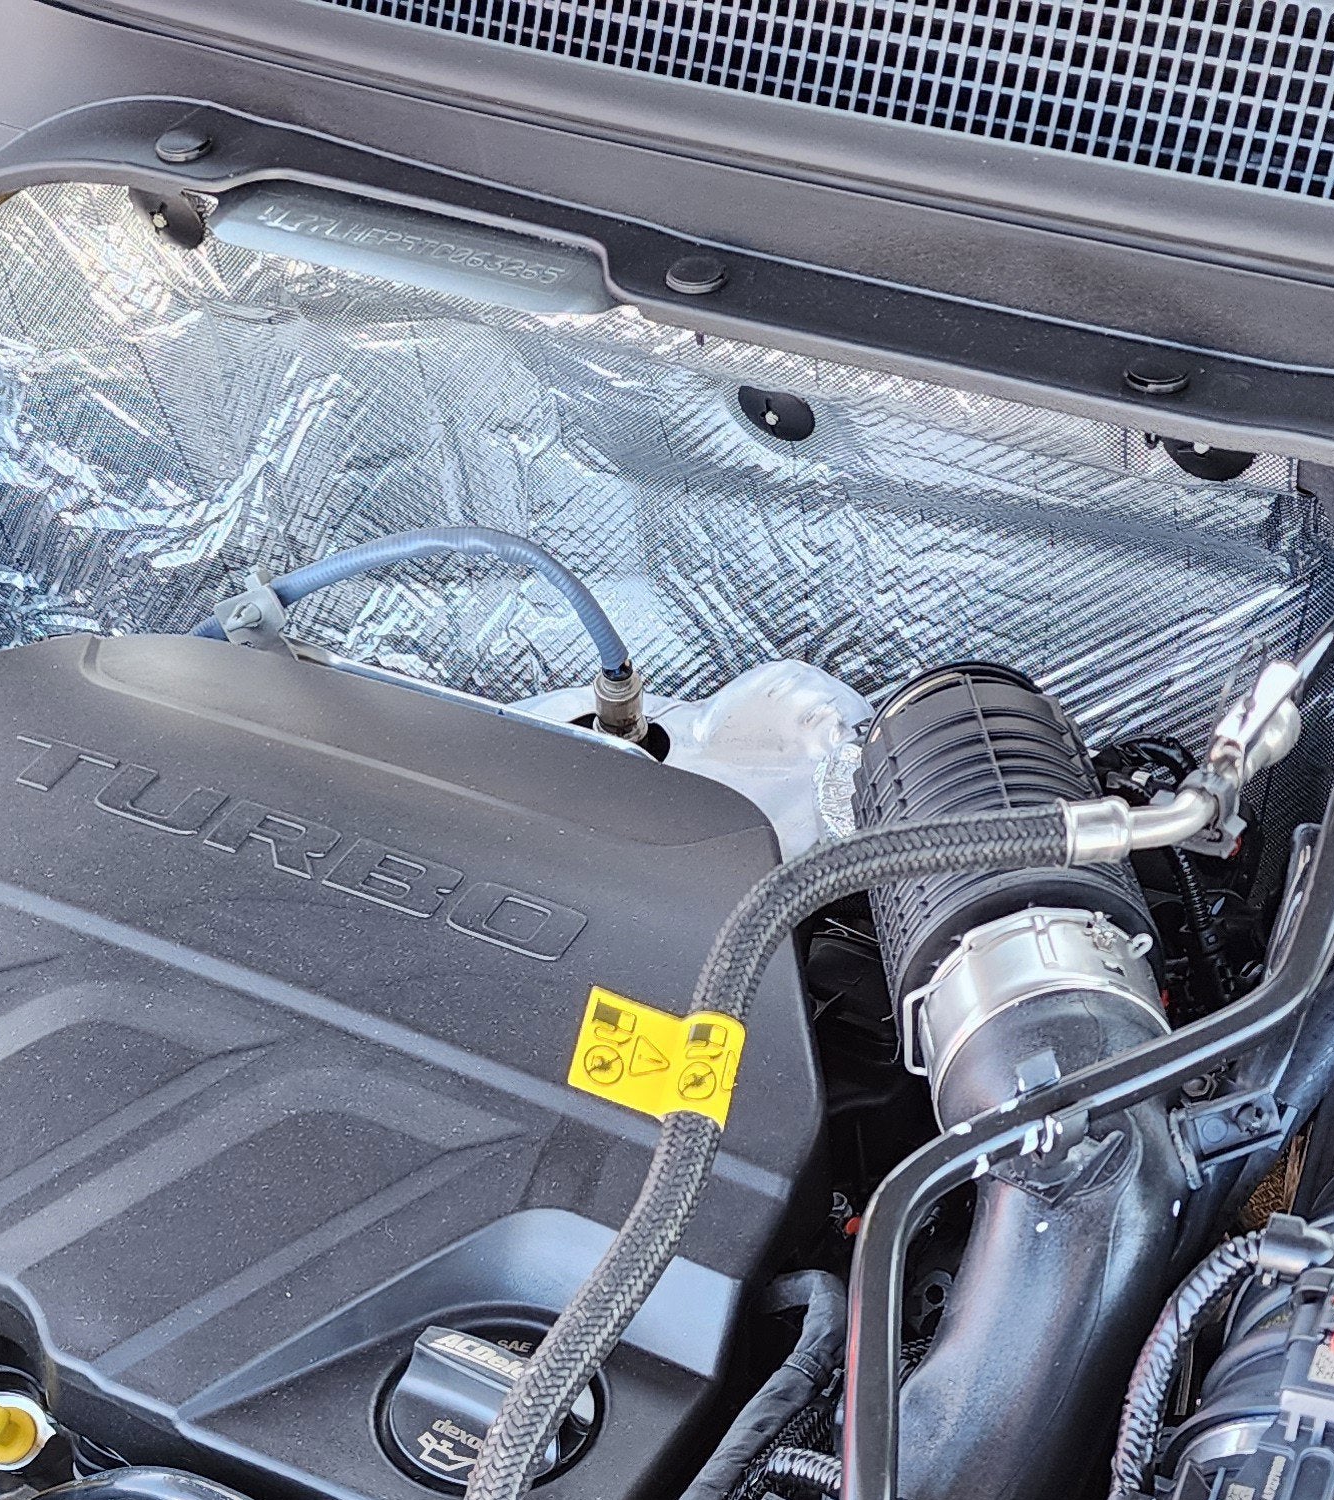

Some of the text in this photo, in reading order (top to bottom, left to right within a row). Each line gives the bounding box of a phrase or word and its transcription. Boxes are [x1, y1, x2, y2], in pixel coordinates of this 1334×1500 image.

[16, 731, 589, 962] TURBO
[431, 1333, 525, 1376] ACDelc
[497, 1339, 534, 1353] SAE
[432, 1419, 485, 1450] dexo
